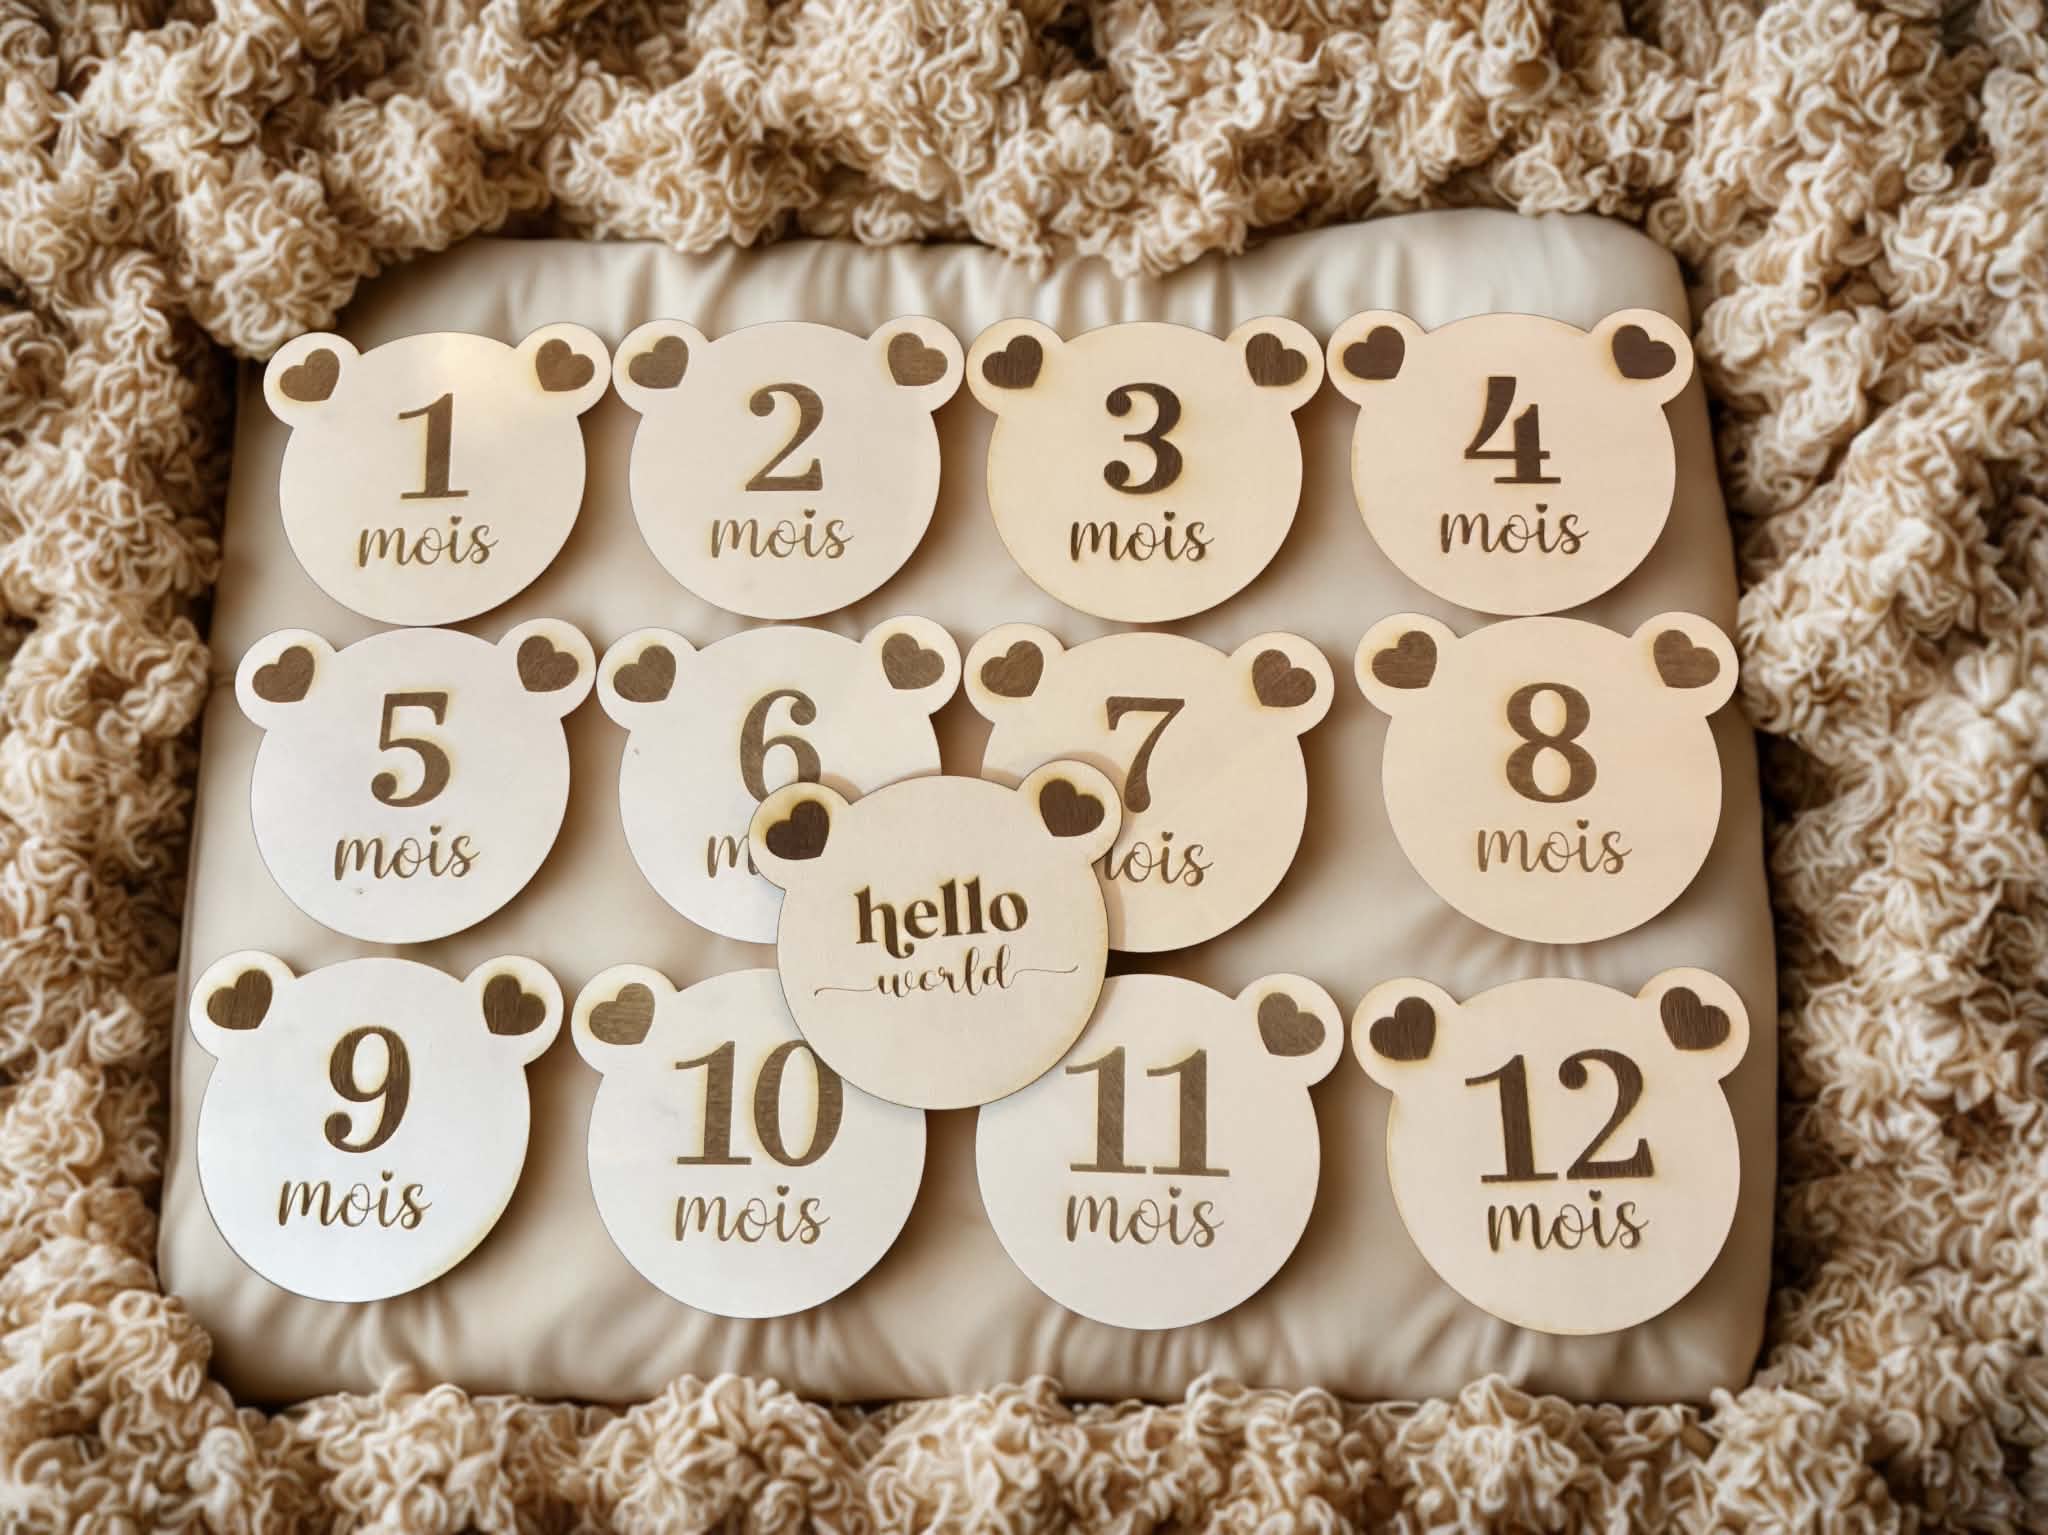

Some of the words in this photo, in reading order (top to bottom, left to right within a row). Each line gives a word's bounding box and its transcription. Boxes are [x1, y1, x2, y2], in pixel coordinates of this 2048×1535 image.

[398, 392, 469, 500] 1
[744, 382, 824, 492] 2
[1103, 382, 1184, 496] 3
[1463, 375, 1562, 485] 4
[358, 515, 499, 568] mois
[711, 509, 852, 559] mois
[1070, 511, 1215, 563] mois
[1440, 503, 1590, 555] mois
[370, 691, 451, 808] 5
[739, 689, 822, 803] 6
[1106, 697, 1185, 814] 7
[1505, 682, 1597, 804] 8
[334, 825, 481, 881] mois
[1104, 831, 1214, 888] ois
[1477, 819, 1633, 875] mois
[854, 877, 1029, 959] hello
[323, 1025, 411, 1154] 9
[674, 1039, 844, 1167] 10
[1064, 1045, 1230, 1177] 11
[1464, 1048, 1656, 1184] 12
[278, 1170, 433, 1230] mois
[675, 1185, 830, 1245] mois
[1066, 1186, 1225, 1248] mois
[1487, 1189, 1649, 1253] mois
